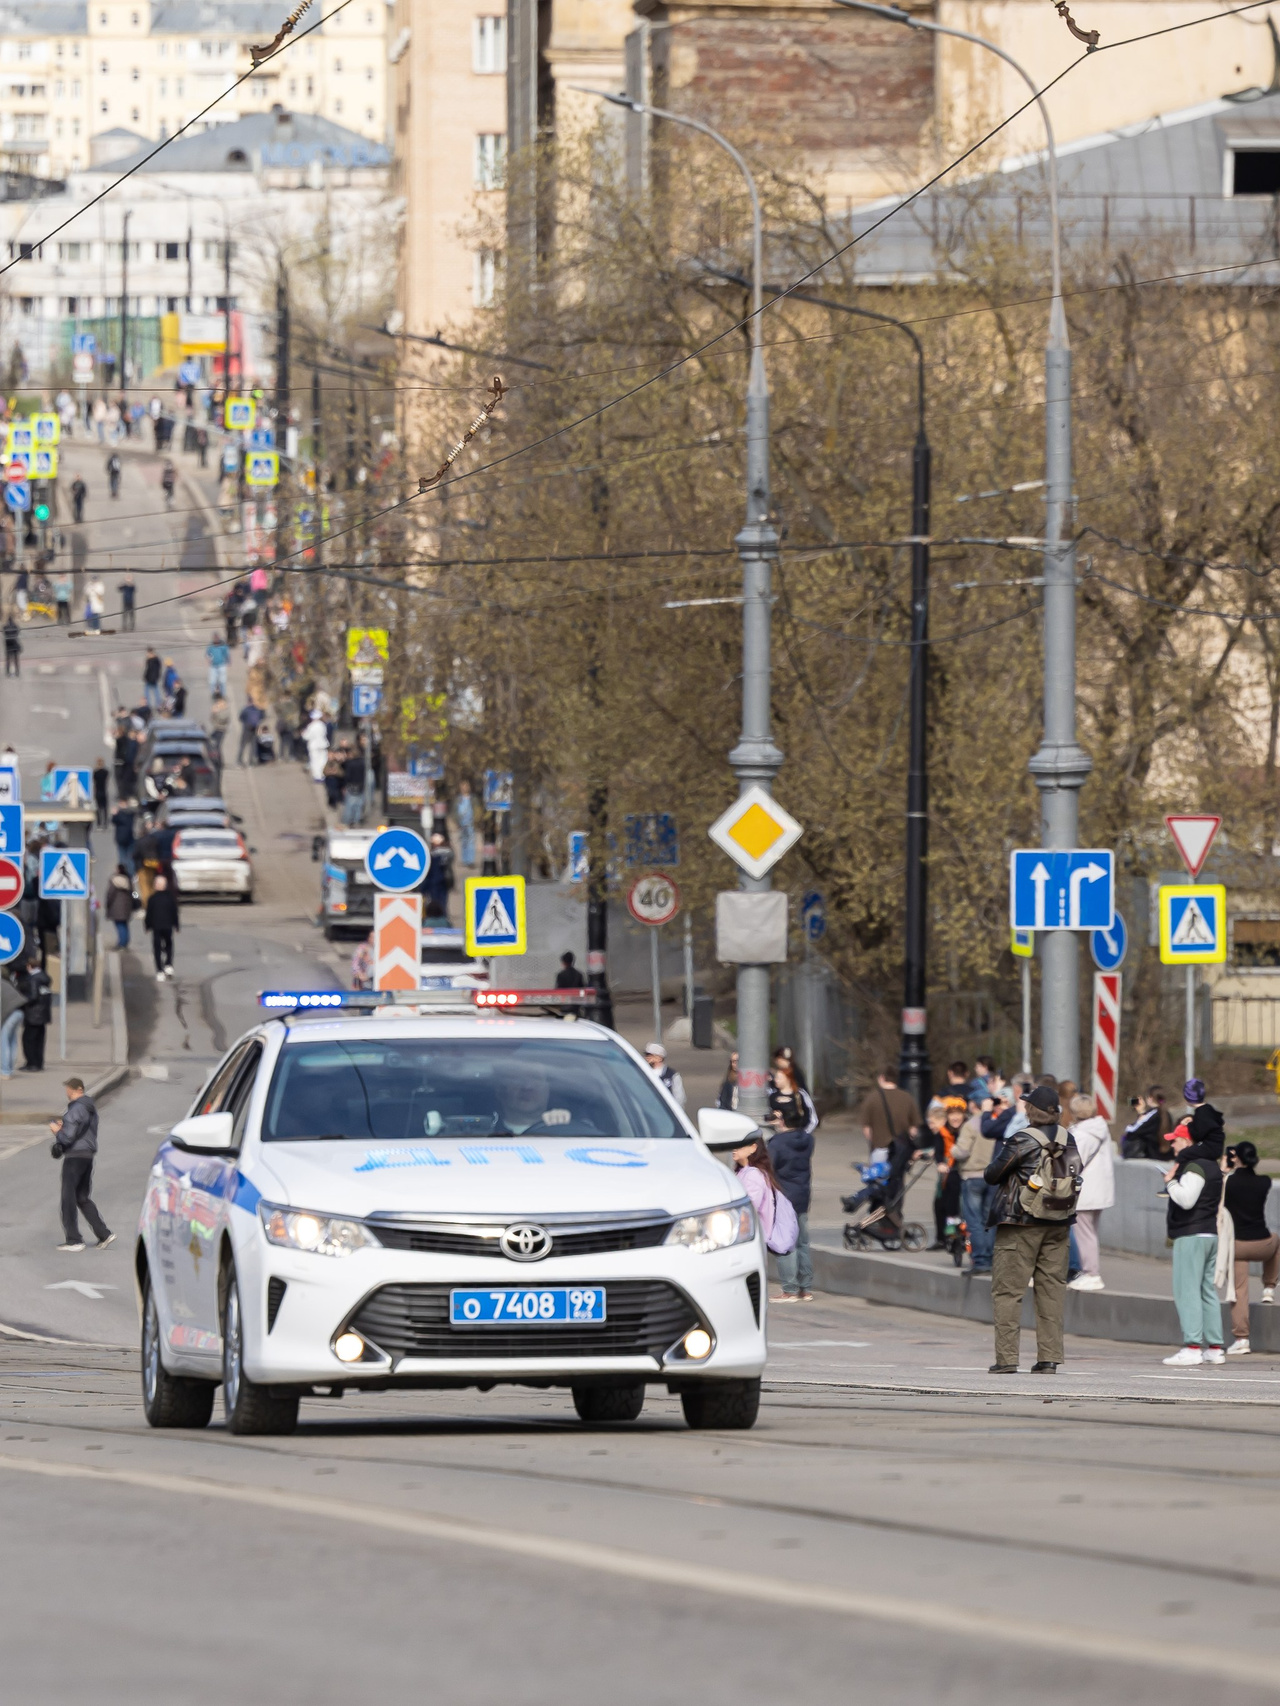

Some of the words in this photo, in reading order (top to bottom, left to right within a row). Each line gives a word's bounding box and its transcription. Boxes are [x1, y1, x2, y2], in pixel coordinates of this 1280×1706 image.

[640, 888, 670, 908] 40
[354, 1146, 650, 1173] ДПС
[489, 1292, 555, 1319] 7408
[570, 1290, 596, 1311] 99
